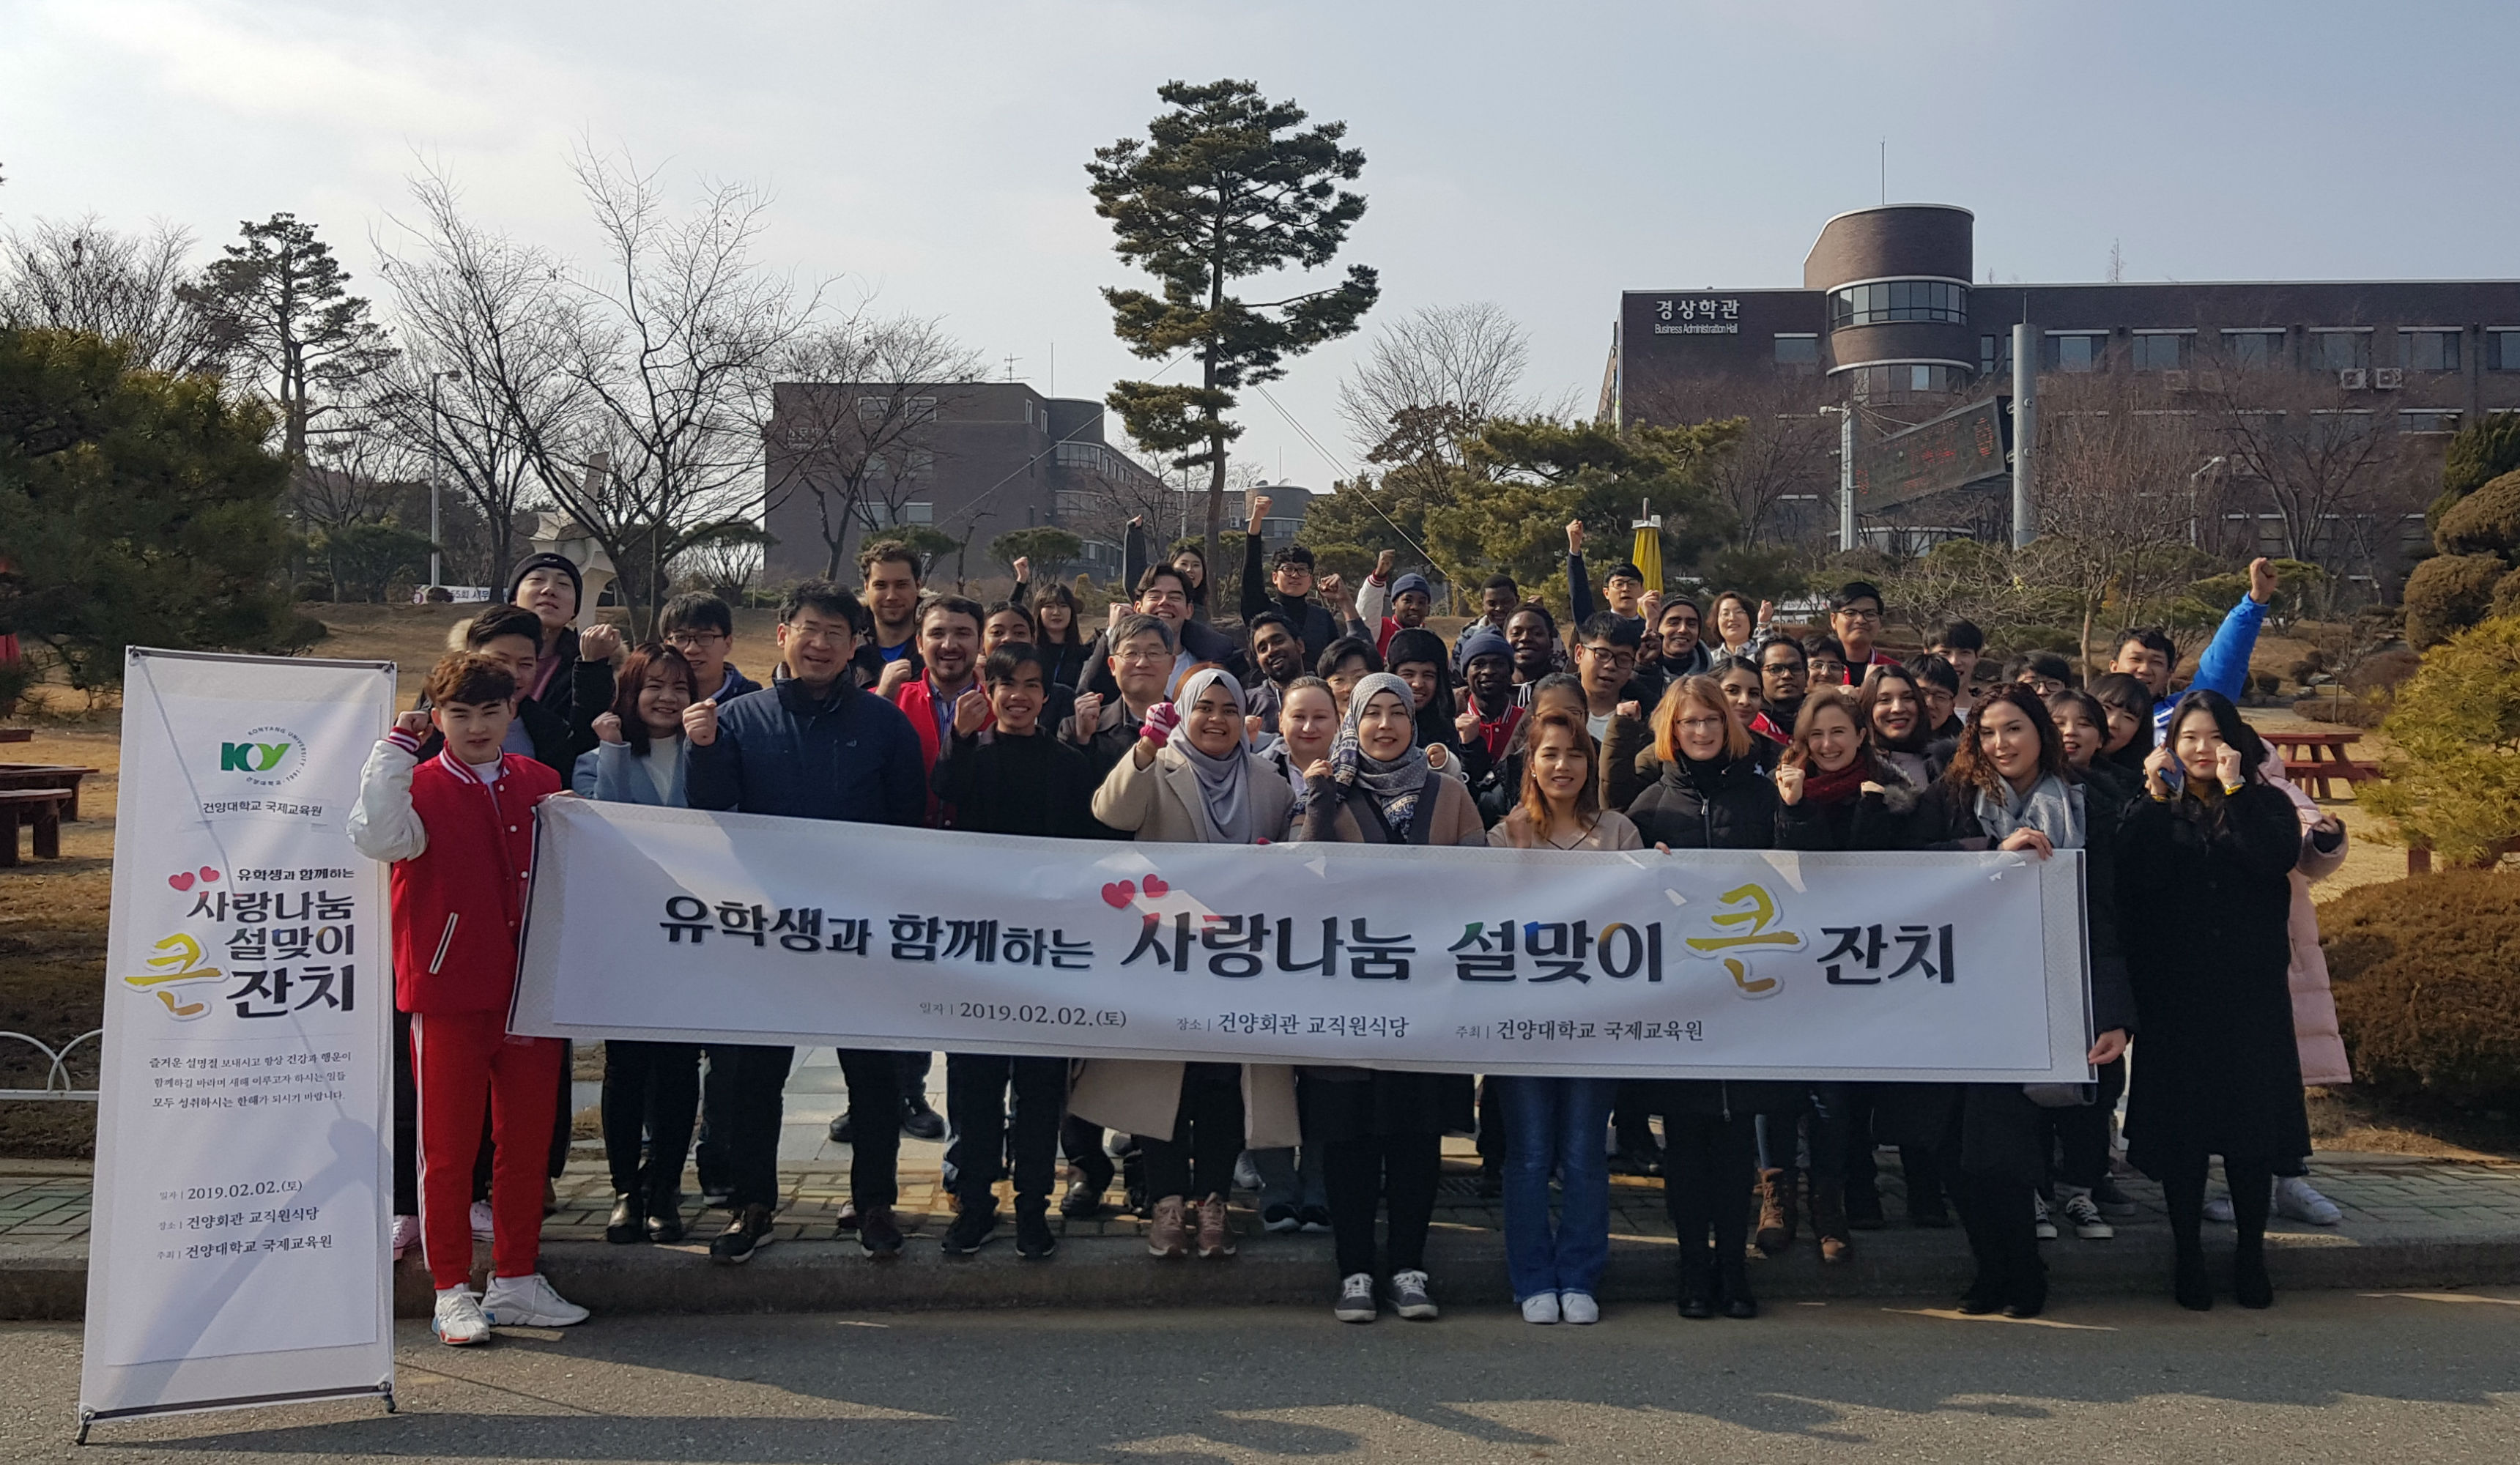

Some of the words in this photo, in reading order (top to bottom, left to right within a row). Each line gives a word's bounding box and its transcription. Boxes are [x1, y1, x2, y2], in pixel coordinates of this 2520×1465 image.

[1656, 299, 1740, 320] 경상학관
[1654, 323, 1683, 334] Business
[1683, 323, 1726, 334] Administration
[1726, 323, 1738, 334] Hall
[247, 725, 286, 736] KONYANG
[220, 741, 292, 773] KY
[202, 800, 262, 814] 건양대학교
[265, 801, 322, 817] 국제교육원
[237, 869, 295, 881] 유학생과
[300, 868, 355, 880] 함께하는
[186, 889, 355, 923] 사랑나눔
[224, 924, 355, 962] 설맞이
[659, 895, 873, 957] 유학생과
[889, 913, 1094, 970] 함께하는
[1119, 911, 1417, 982] 사랑나눔
[1446, 919, 1663, 984] 설맞이
[1686, 882, 1803, 993] 큰
[1818, 923, 1954, 986] 잔치
[125, 933, 223, 1016] 큰
[226, 964, 355, 1020] 잔치
[919, 1001, 944, 1015] 일자
[960, 1002, 1127, 1027] 2019.02.02.(토)
[1176, 1017, 1202, 1031] 장소
[1218, 1012, 1300, 1034] 건양회관
[1306, 1015, 1410, 1037] 교직원식당
[1456, 1025, 1480, 1039] 주최
[1497, 1019, 1597, 1040] 건양대학교
[1605, 1020, 1703, 1042] 국제교육원
[149, 1057, 182, 1069] 즐거운
[185, 1057, 218, 1069] 설명절
[220, 1057, 261, 1069] 보내시고
[264, 1055, 283, 1067] 항상
[286, 1053, 316, 1065] 건강과
[321, 1050, 351, 1063] 행운이
[155, 1078, 193, 1088] 함께하길
[229, 1075, 249, 1088] 새해
[252, 1074, 291, 1086] 이루고자
[294, 1072, 323, 1084] 하시는
[326, 1070, 346, 1083] 일들
[152, 1097, 174, 1108] 모두
[178, 1095, 233, 1109] 성취하시는
[237, 1094, 268, 1107] 한해가
[272, 1092, 300, 1105] 되시기
[304, 1090, 345, 1102] 바랍니다.
[188, 1180, 303, 1200] 2019.02.02.(토)
[187, 1212, 244, 1230] 건양회관
[248, 1206, 319, 1223] 교직원식당
[185, 1241, 257, 1259] 건양대학교
[262, 1234, 333, 1253] 국제교육원
